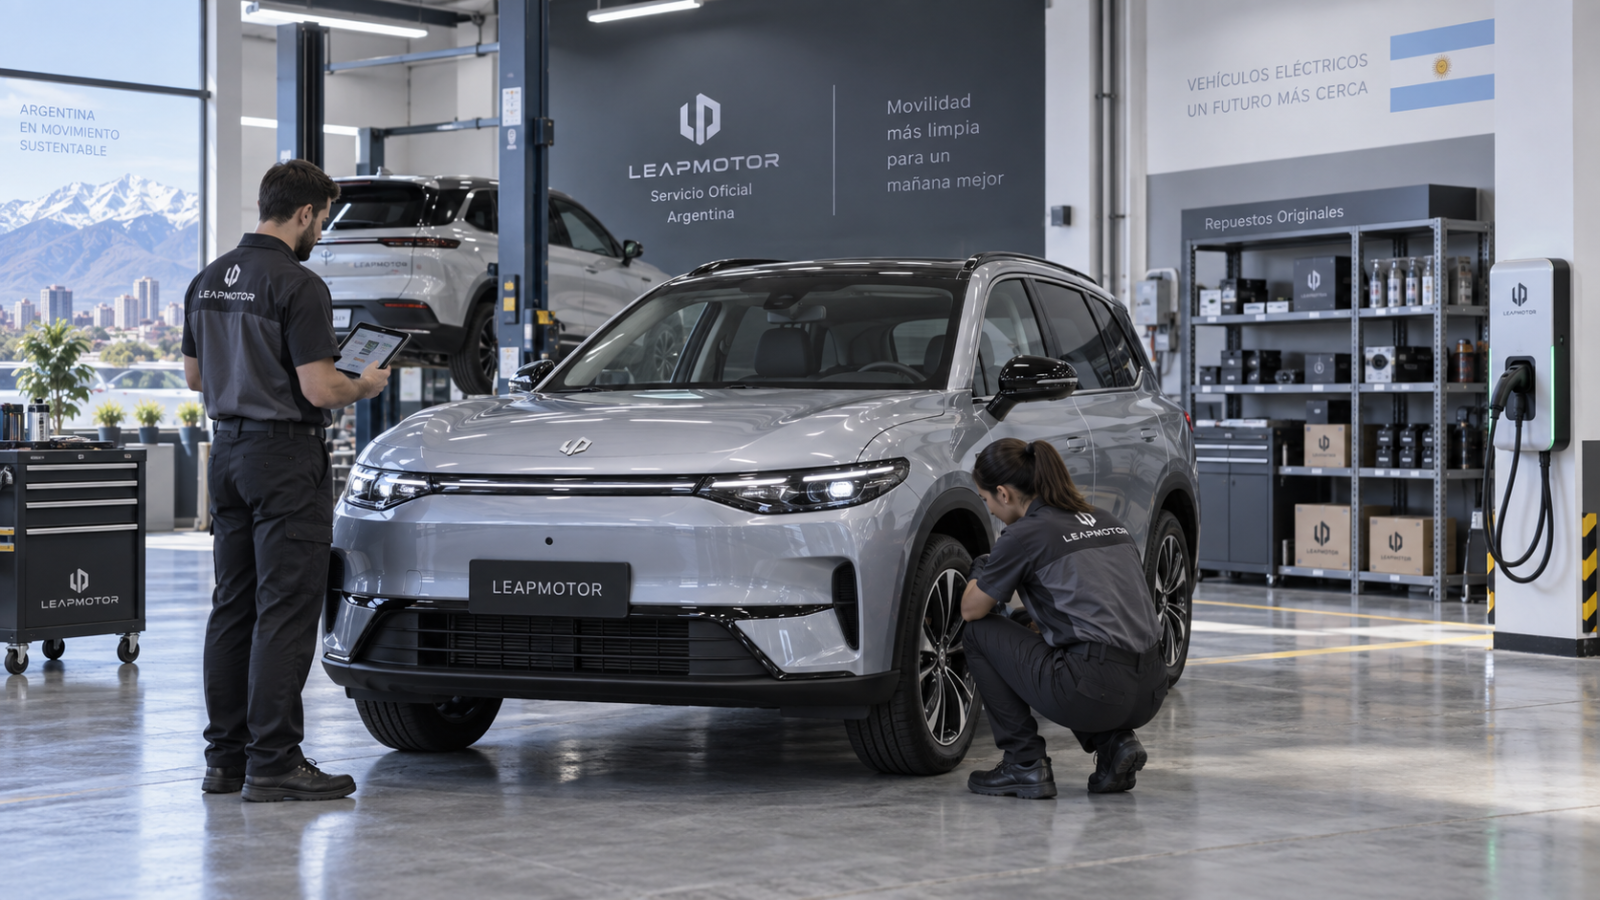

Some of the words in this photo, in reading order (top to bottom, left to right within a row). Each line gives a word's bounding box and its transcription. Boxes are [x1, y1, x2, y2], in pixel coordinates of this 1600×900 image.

[1187, 69, 1269, 92] VEHÍCULOS
[1275, 53, 1369, 80] ELÉCTRICOS
[887, 93, 971, 115] Movilidad
[1187, 102, 1208, 118] UN
[1213, 94, 1272, 115] FUTURO
[1277, 86, 1310, 106] MÁS
[1316, 81, 1369, 101] CERCA
[20, 103, 95, 121] ARGENTINA
[20, 121, 37, 134] EN
[41, 123, 120, 140] MOVIMIENTO
[887, 124, 922, 141] más
[928, 119, 980, 139] limpia
[20, 139, 107, 157] SUSTENTABLE
[628, 153, 780, 179] LEAPMOTOR
[887, 153, 924, 170] para
[930, 151, 950, 164] un
[887, 176, 951, 193] mañana
[957, 171, 1005, 190] mejor
[650, 187, 704, 202] Servicio
[708, 182, 752, 198] Oficial
[667, 207, 735, 225] Argentina
[1205, 214, 1273, 232] Repuestos
[1277, 206, 1345, 224] Originales
[198, 290, 256, 302] LEAPMOTOR
[1062, 526, 1129, 543] LEAPMOTOR
[492, 580, 603, 597] LEAPMOTOR
[41, 596, 119, 609] LEAPMOTOR
